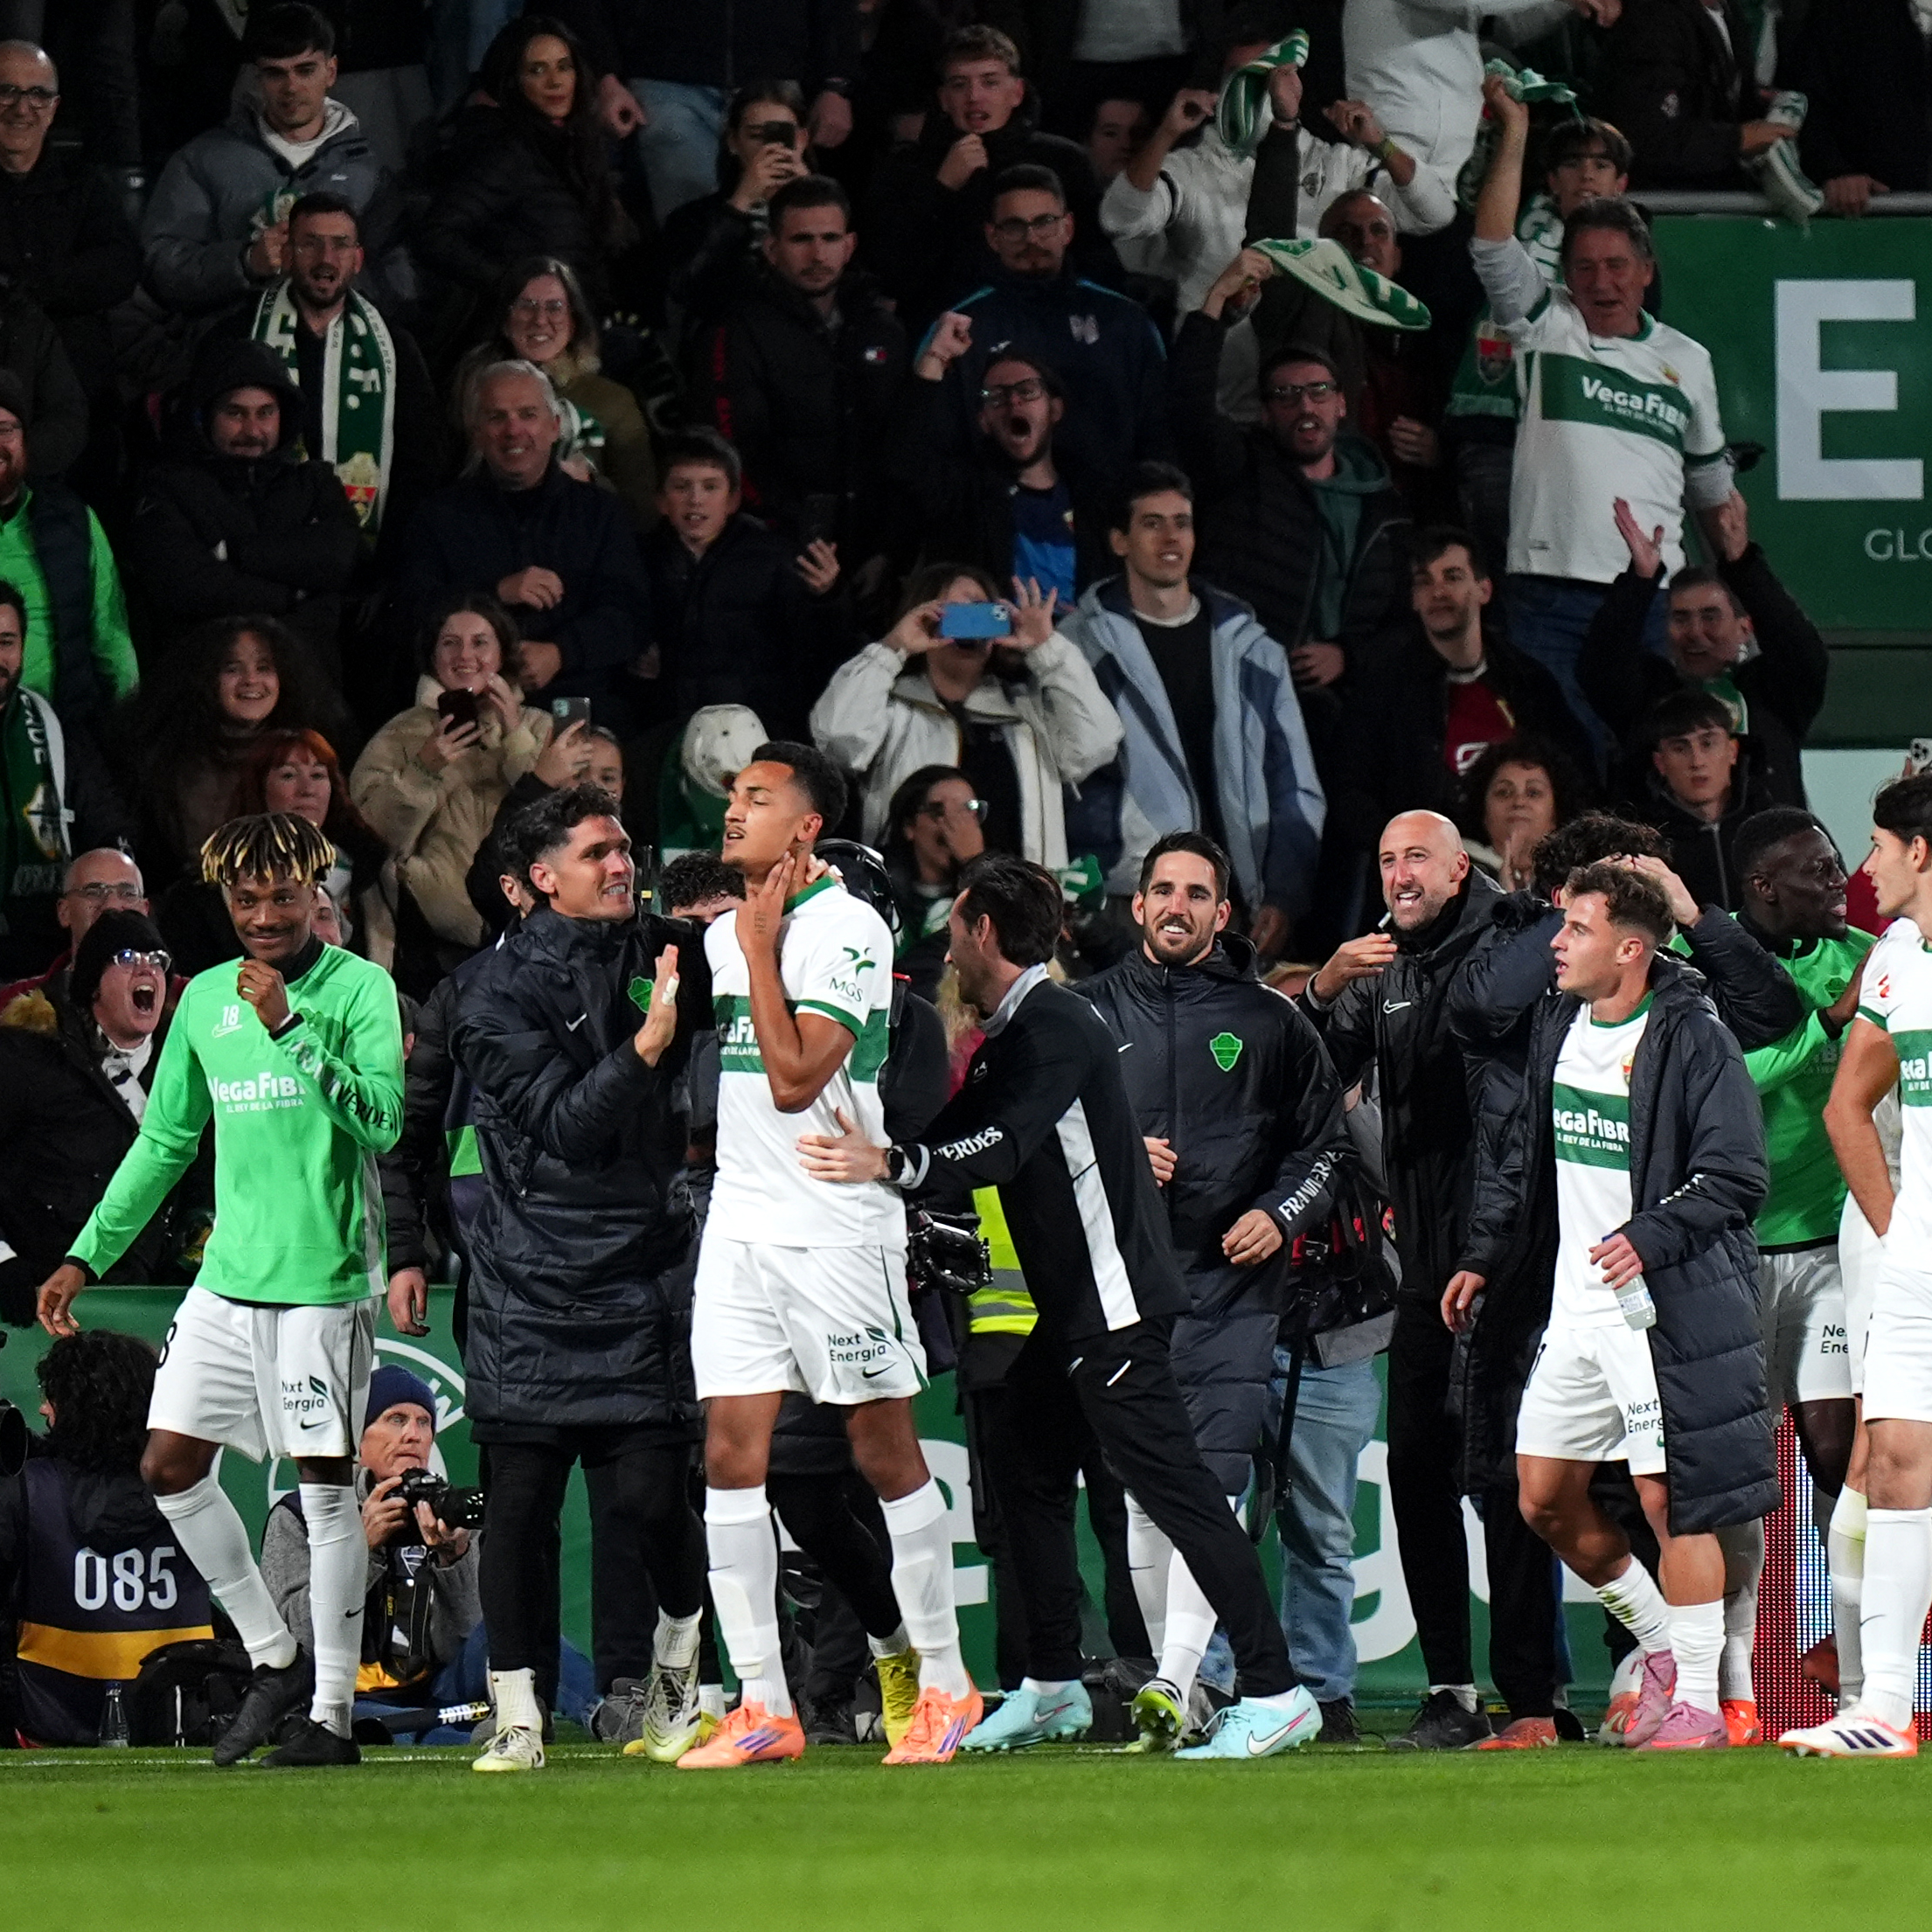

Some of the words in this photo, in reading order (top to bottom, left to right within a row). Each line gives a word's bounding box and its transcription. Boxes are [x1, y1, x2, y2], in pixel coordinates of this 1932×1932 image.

[830, 977, 863, 1002] MGS
[221, 1005, 240, 1026] 18
[275, 1099, 304, 1108] FIBRA
[1579, 1137, 1590, 1148] DE
[1591, 1138, 1601, 1149] LA
[1602, 1141, 1624, 1153] FIBRA
[827, 1332, 861, 1346] Next
[1822, 1324, 1847, 1338] Ne
[830, 1343, 886, 1362] Energía
[1626, 1398, 1659, 1417] Next
[74, 1546, 178, 1612] 085
